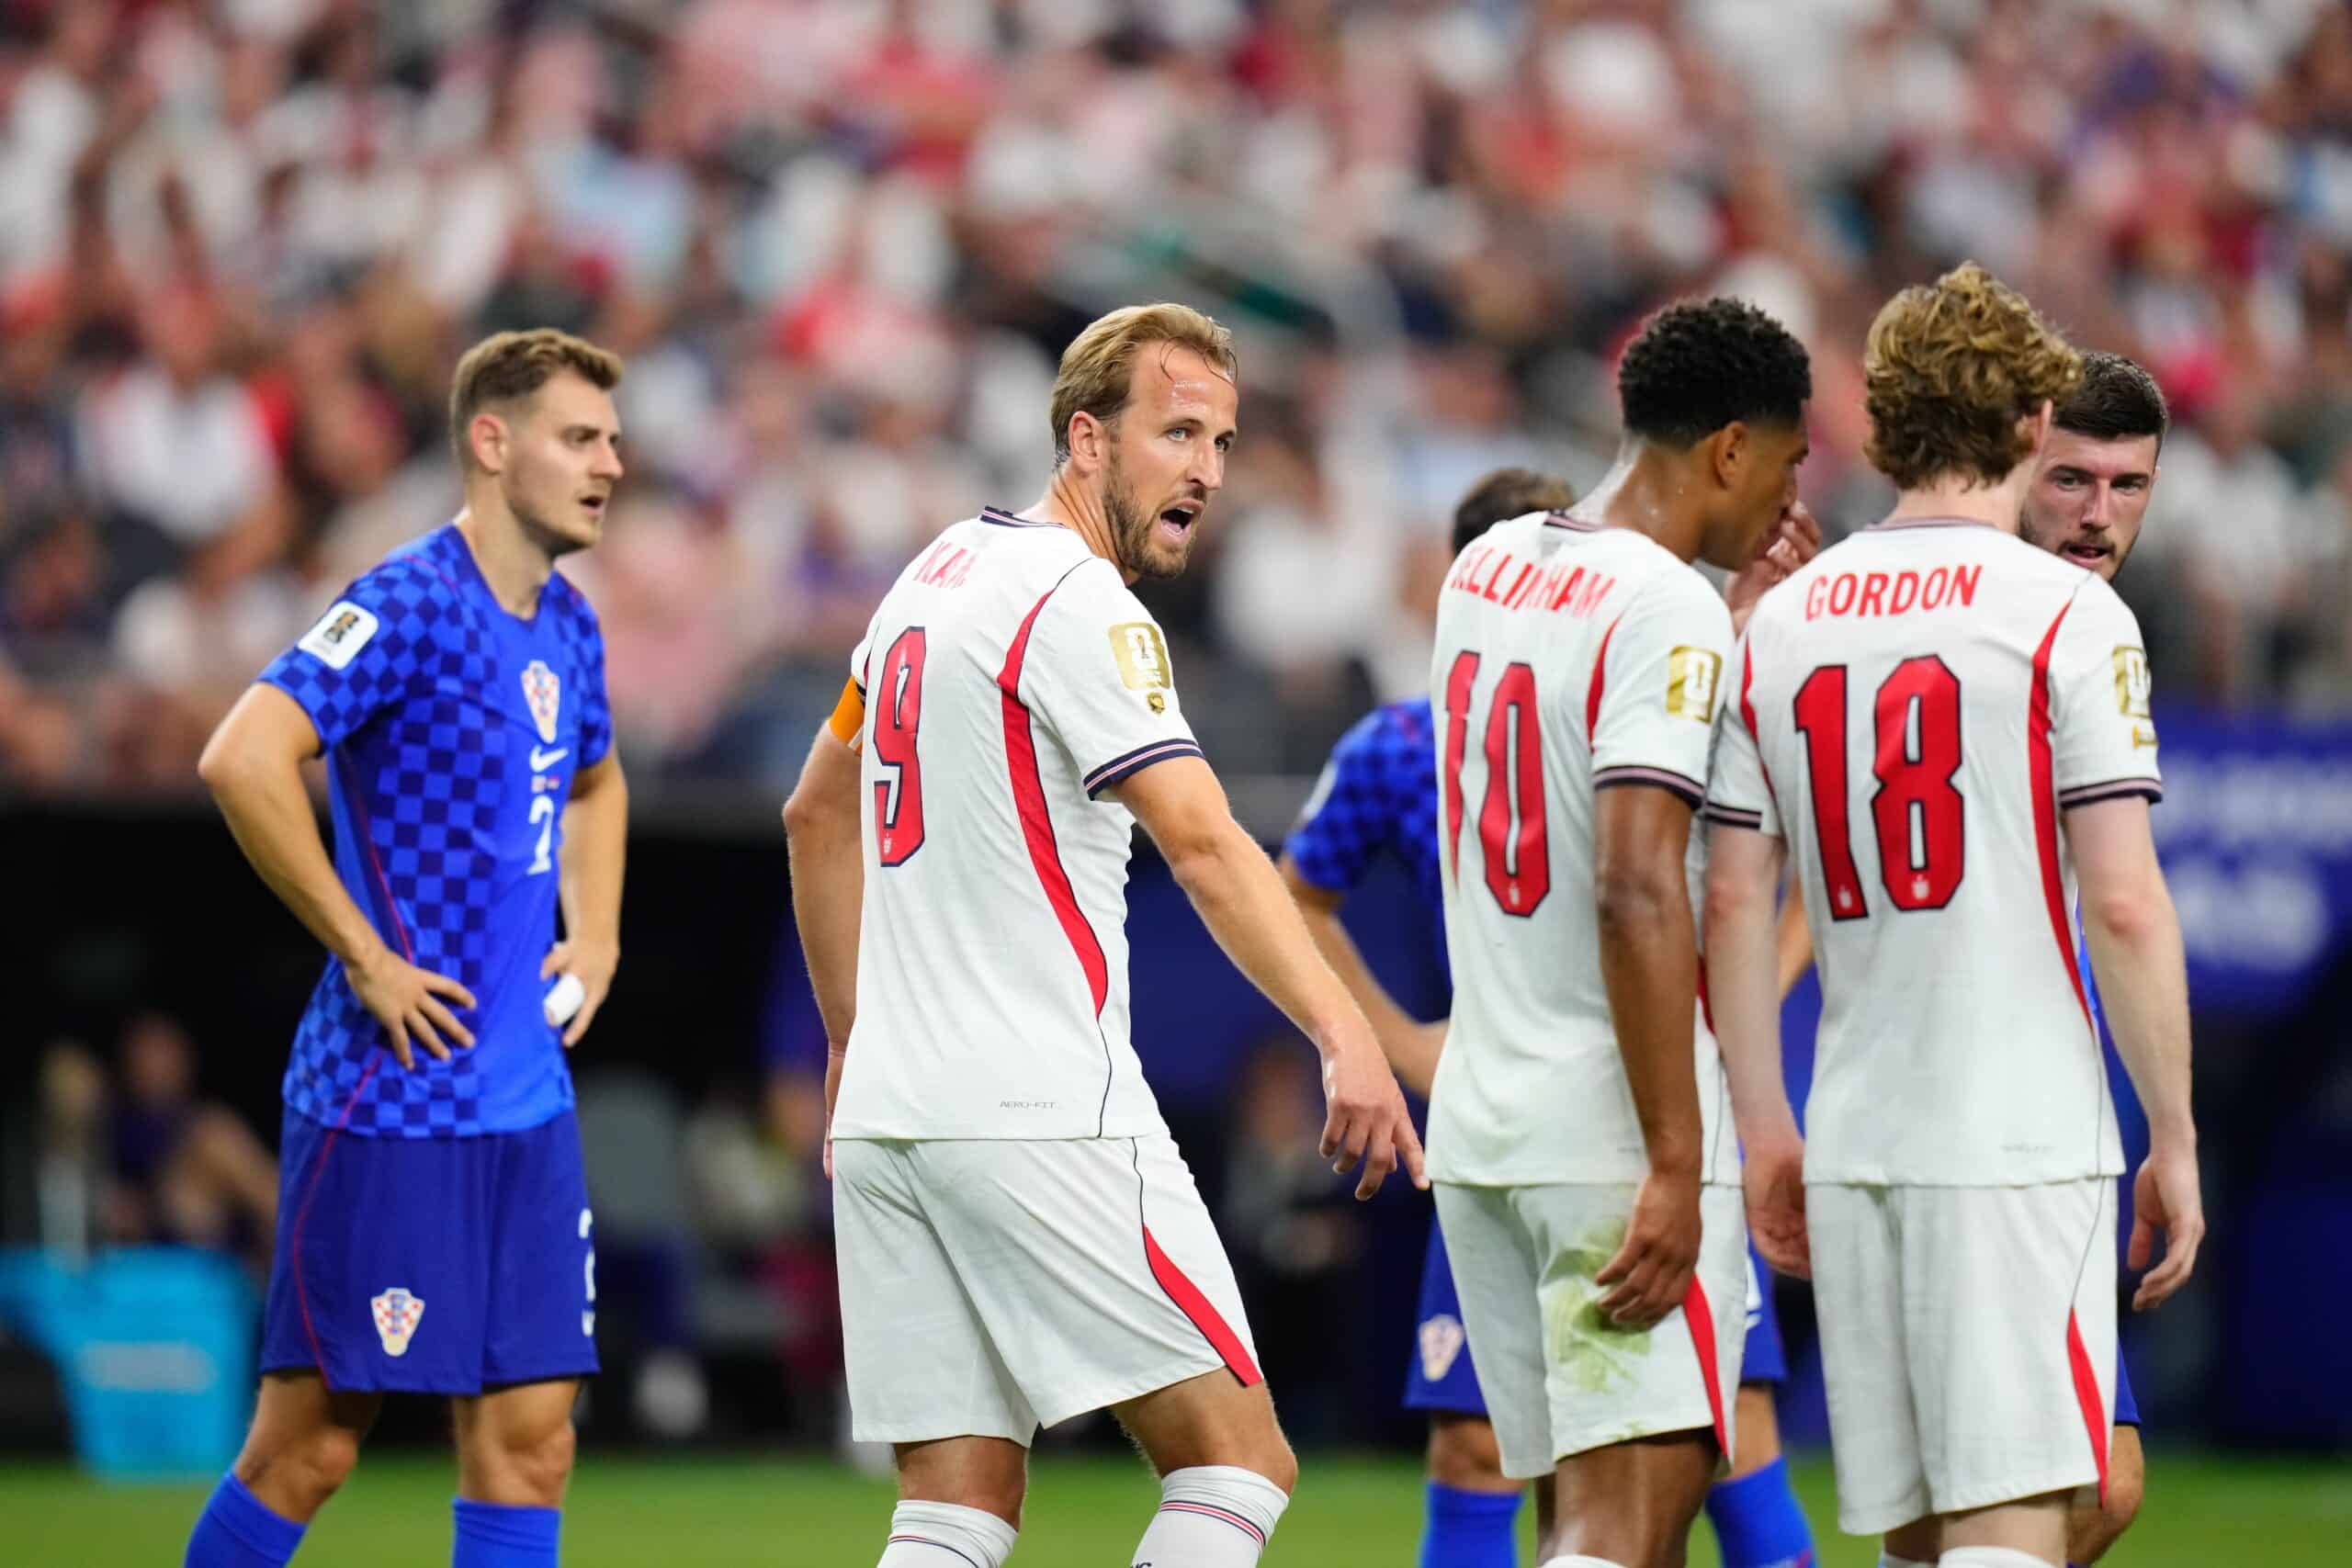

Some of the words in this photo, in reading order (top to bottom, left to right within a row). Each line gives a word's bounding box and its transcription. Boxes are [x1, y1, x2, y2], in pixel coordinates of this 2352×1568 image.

[1805, 564, 1982, 622] GORDON
[527, 795, 554, 875] 2
[873, 626, 926, 867] 9
[1444, 649, 1550, 918] 10
[1793, 653, 1965, 922] 18
